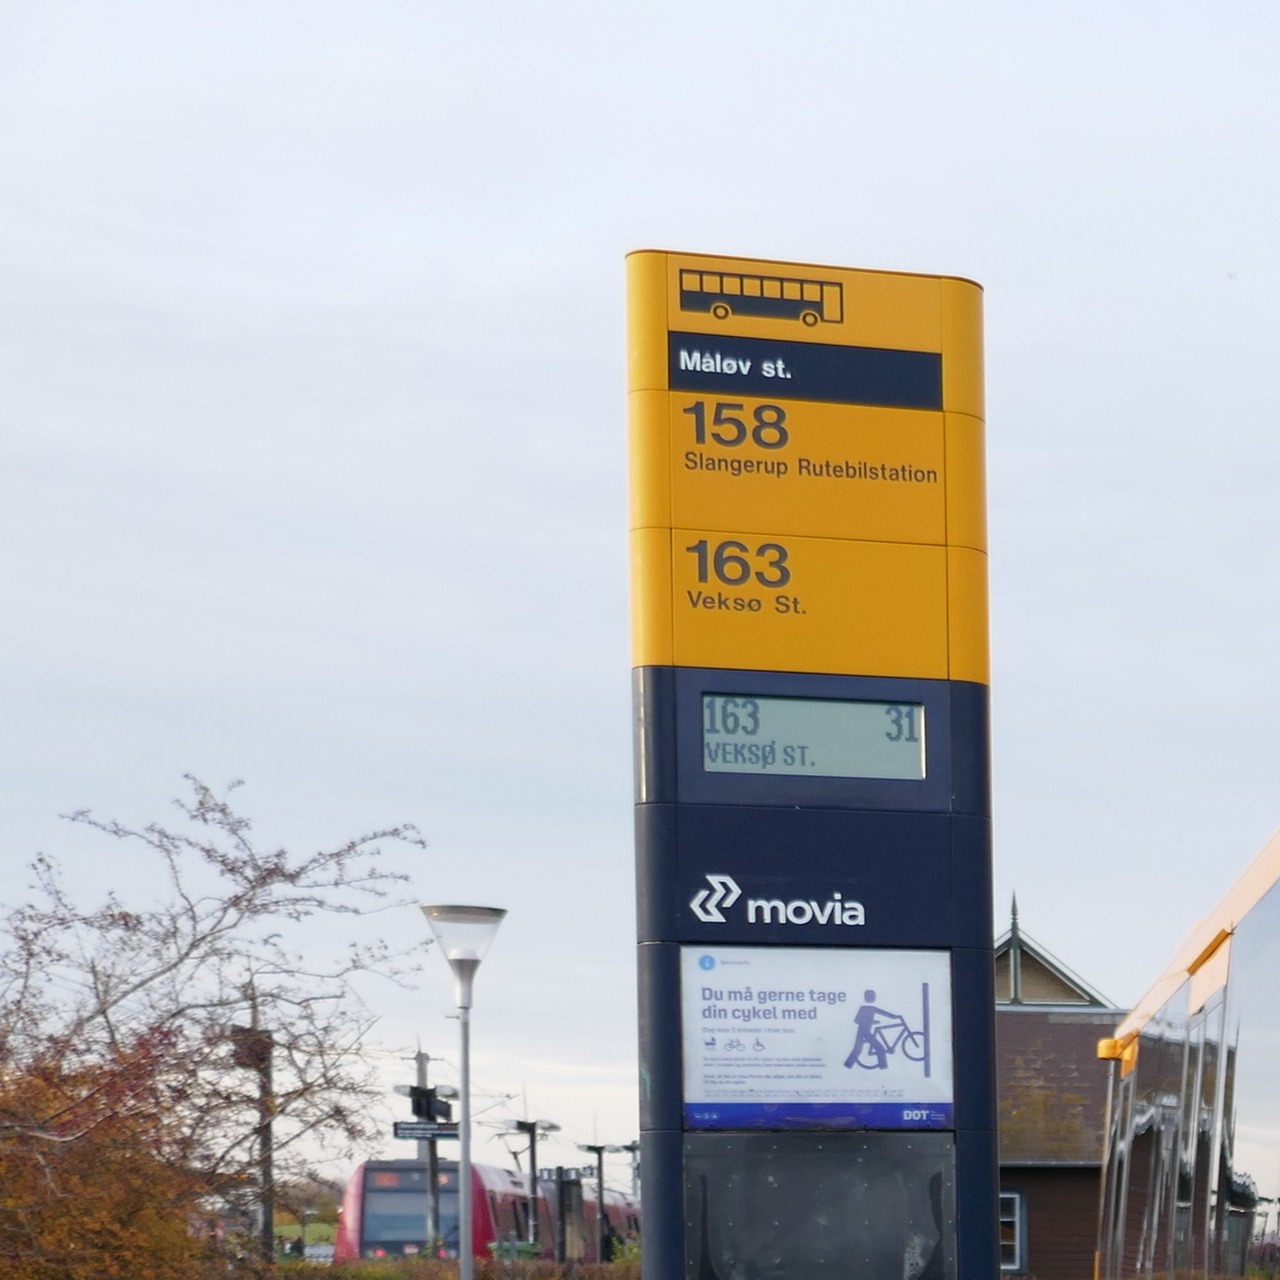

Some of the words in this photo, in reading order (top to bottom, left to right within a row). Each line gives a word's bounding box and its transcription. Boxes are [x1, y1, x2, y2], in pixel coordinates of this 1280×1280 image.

[680, 349, 752, 376] Måløv
[762, 360, 792, 379] st.
[683, 401, 789, 450] 158
[684, 451, 788, 477] Slangerup
[798, 458, 937, 484] Rutebilstation
[685, 540, 791, 588] 163
[687, 590, 762, 613] Veksø
[774, 594, 807, 616] St.
[704, 697, 760, 736] 163
[884, 706, 920, 743] 31
[705, 740, 777, 770] VEKSØ
[782, 744, 816, 768] ST.
[747, 893, 866, 926] movia
[701, 987, 724, 1001] Du
[728, 986, 753, 1001] må
[757, 990, 805, 1004] gerne
[808, 989, 847, 1005] tage
[702, 1004, 728, 1019] din
[732, 1006, 778, 1022] cykel
[782, 1007, 818, 1020] med
[903, 1110, 930, 1121] DOT
